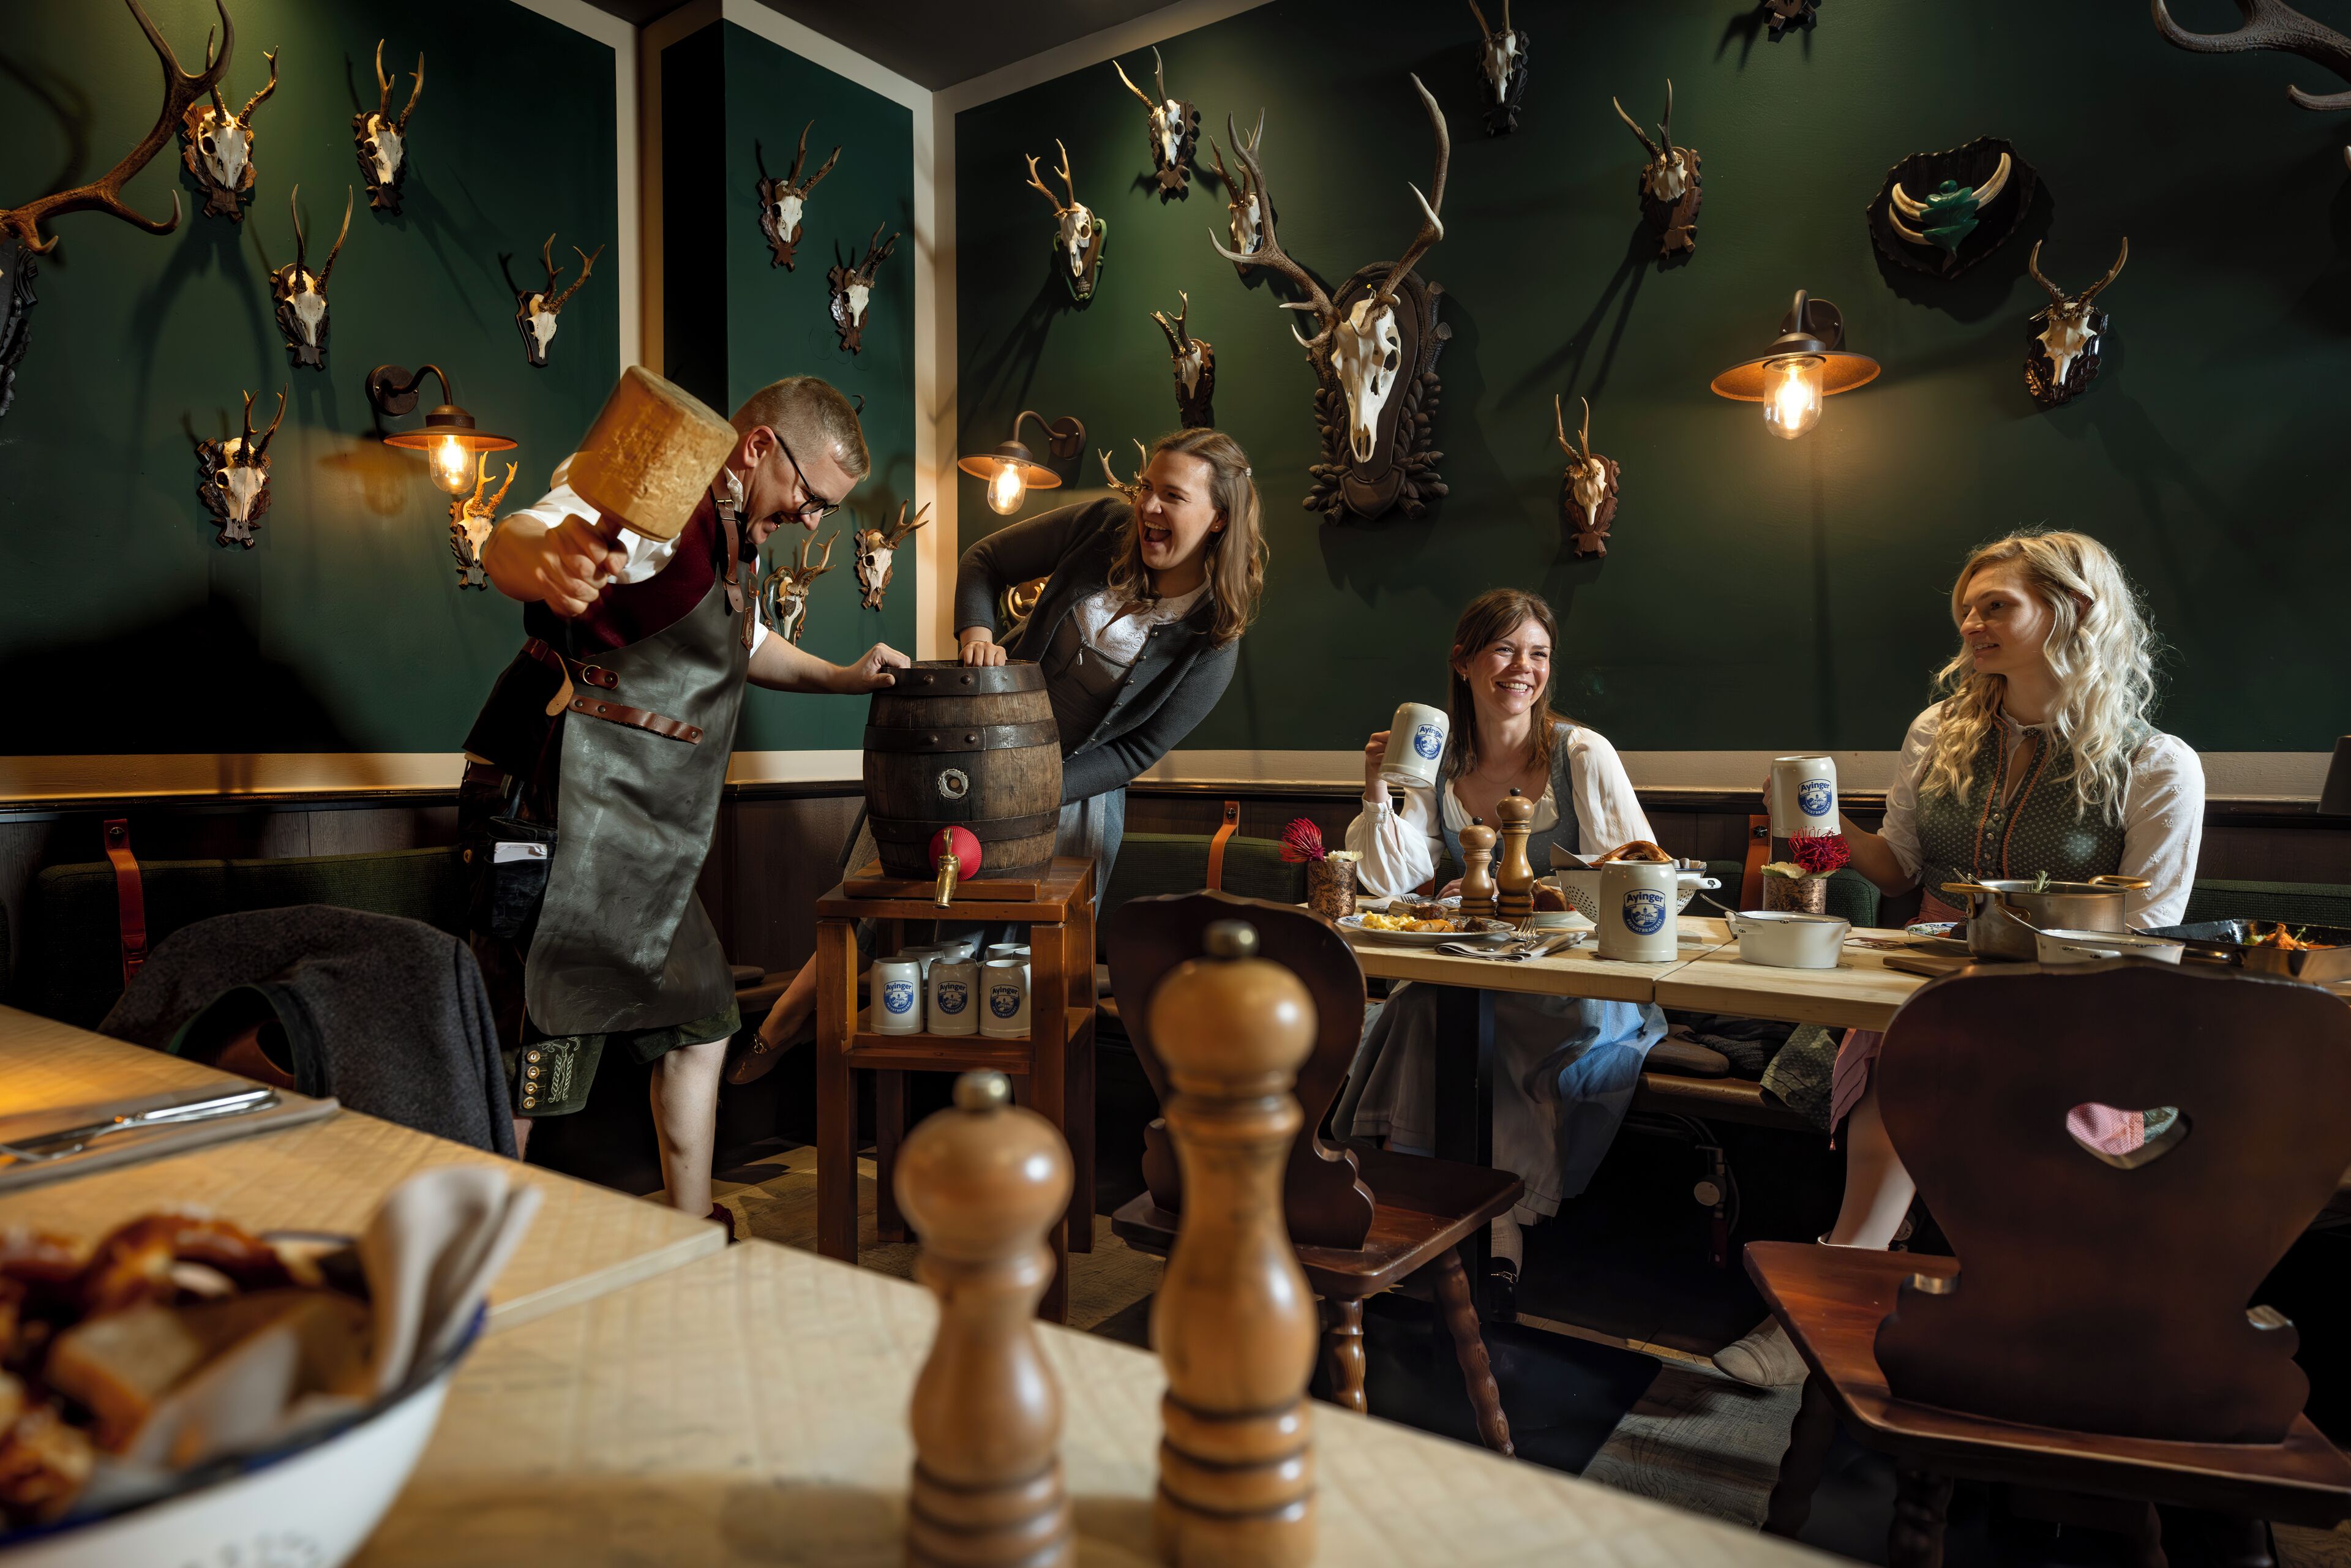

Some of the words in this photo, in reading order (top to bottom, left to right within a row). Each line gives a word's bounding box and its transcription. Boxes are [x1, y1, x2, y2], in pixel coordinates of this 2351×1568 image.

[1420, 726, 1443, 740] Ayinger
[1801, 782, 1830, 792] Ayinger
[1802, 801, 1831, 815] PRIVATBRAUEREI
[1627, 891, 1663, 903] Ayinger
[1626, 918, 1663, 932] PRIVATBRAUEREI
[885, 983, 912, 991] Ayinger
[939, 983, 966, 991] Ayinger
[992, 986, 1018, 996] Ayinger
[885, 1001, 911, 1013] PRIVATBRAUEREI
